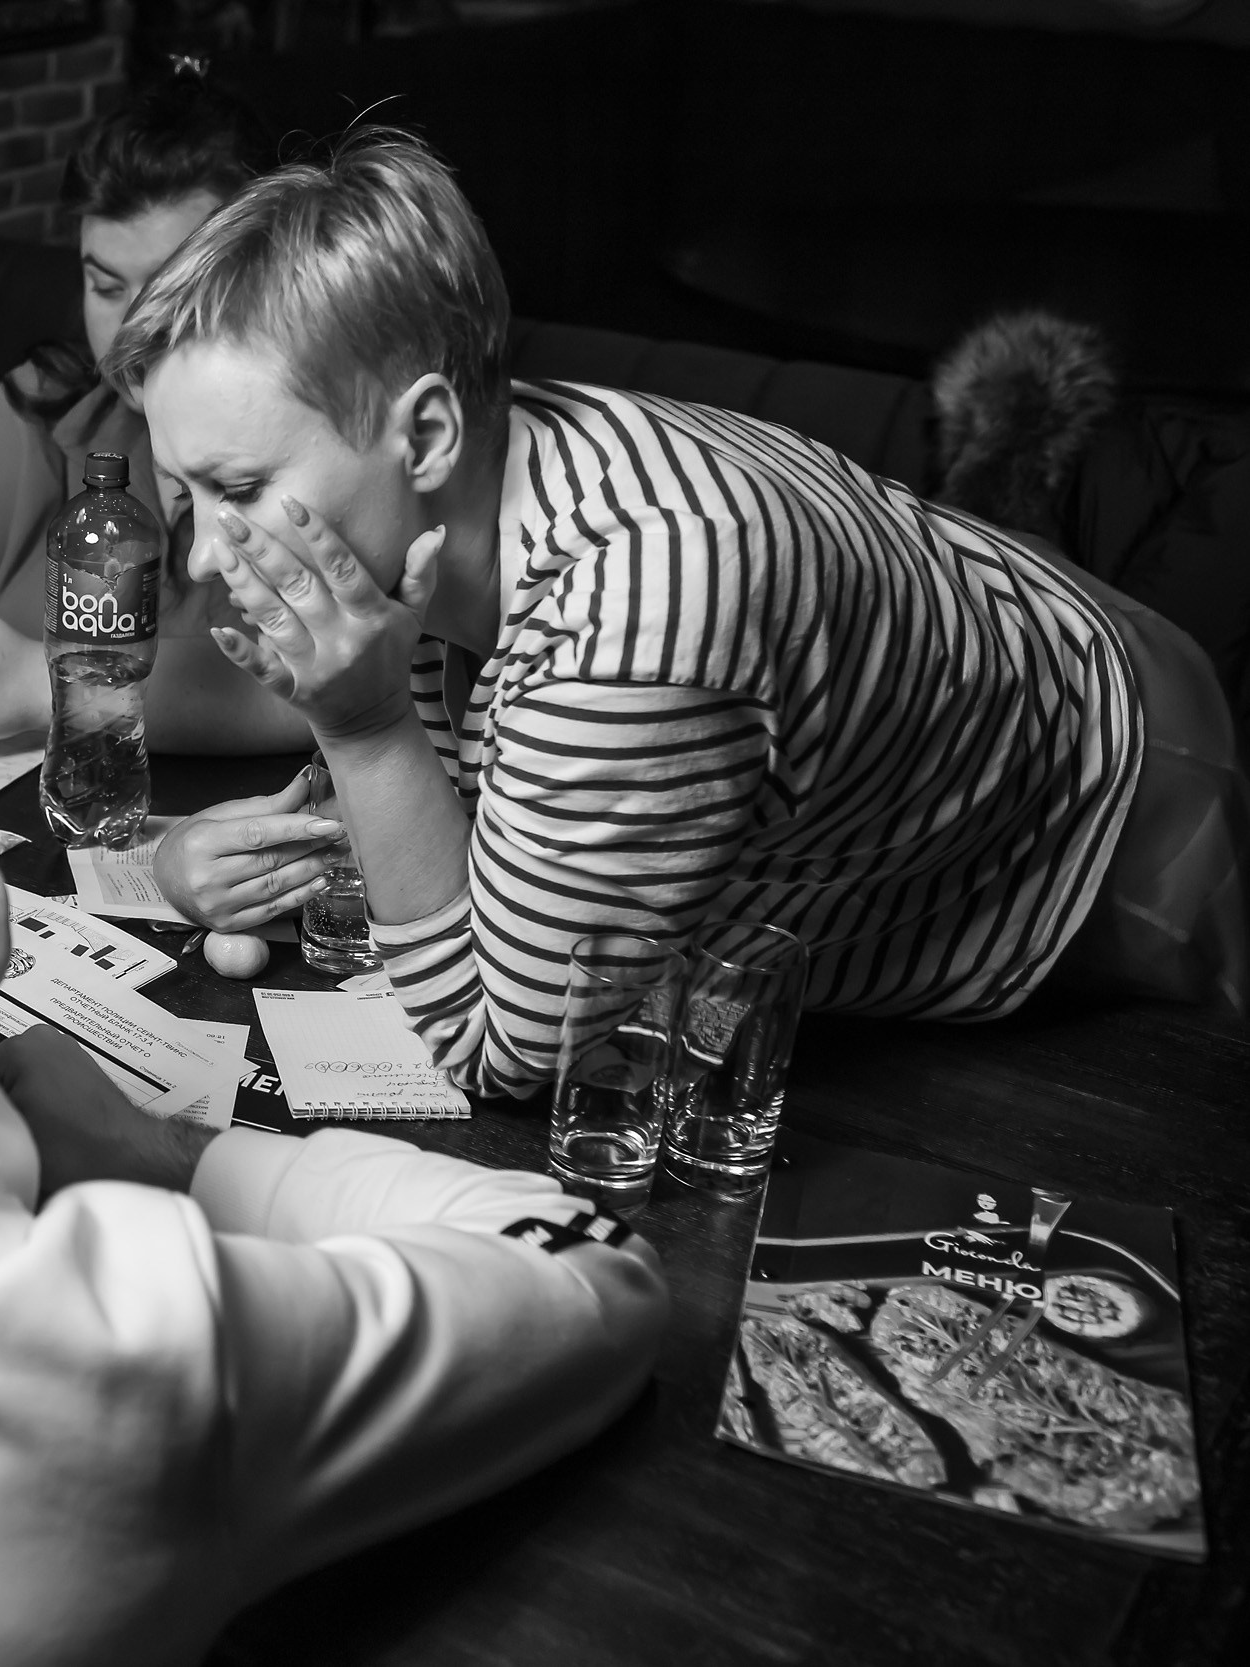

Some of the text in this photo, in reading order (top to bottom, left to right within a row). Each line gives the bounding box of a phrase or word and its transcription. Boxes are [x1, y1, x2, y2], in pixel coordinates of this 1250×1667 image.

[62, 586, 117, 613] bon
[62, 611, 135, 637] aqua
[50, 978, 188, 1058] ДЕПАРТАМЕНТ ПОЛИЦИИ СЕЙНТ-ТВИНС
[50, 997, 120, 1040] ПРЕДВАРИТЕЛЬНЫЙ
[119, 1038, 145, 1054] ОТЧЕТ
[63, 1013, 123, 1050] ПРОИСШЕСТВИИ
[70, 996, 109, 1020] ОТЧЕТНЫЙ
[108, 1018, 133, 1035] БЛАНК
[924, 1231, 1042, 1272] Gioconda
[922, 1260, 1042, 1299] МЕНЮ
